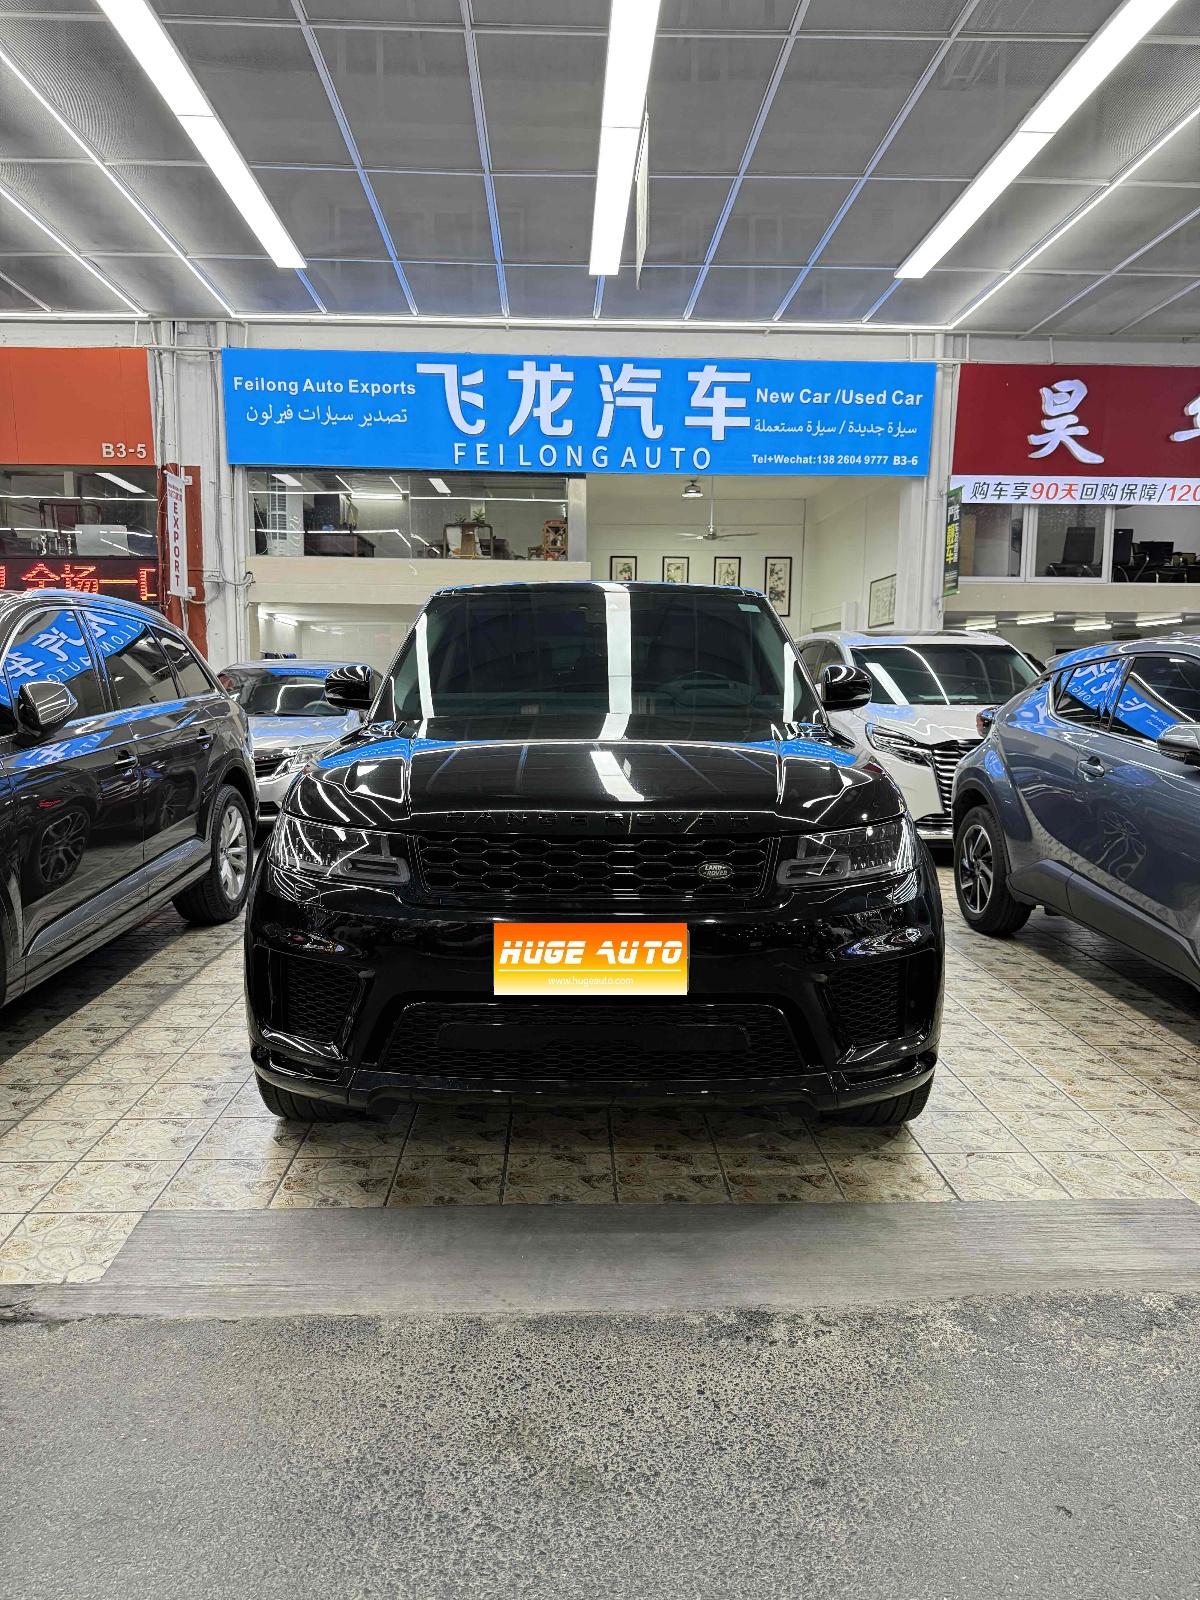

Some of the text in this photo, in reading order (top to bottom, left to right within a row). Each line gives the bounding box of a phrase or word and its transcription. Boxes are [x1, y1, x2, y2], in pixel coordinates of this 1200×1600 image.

[233, 377, 416, 397] Feilong Auto Exports
[416, 360, 752, 441] 飞龙汽车
[756, 388, 795, 404] New
[800, 389, 831, 405] Car
[891, 390, 923, 406] Car
[298, 405, 354, 426] سيارات
[358, 408, 408, 427] تصدير
[754, 418, 803, 433] مستعملة
[805, 419, 836, 436] سيارة
[848, 421, 884, 436] جديدة
[887, 421, 917, 437] سيارة
[101, 443, 147, 459] B3-5
[837, 455, 862, 465] 2604
[863, 455, 889, 465] 9777
[892, 456, 918, 466] B3-6
[446, 811, 749, 828] RANGE ROVER
